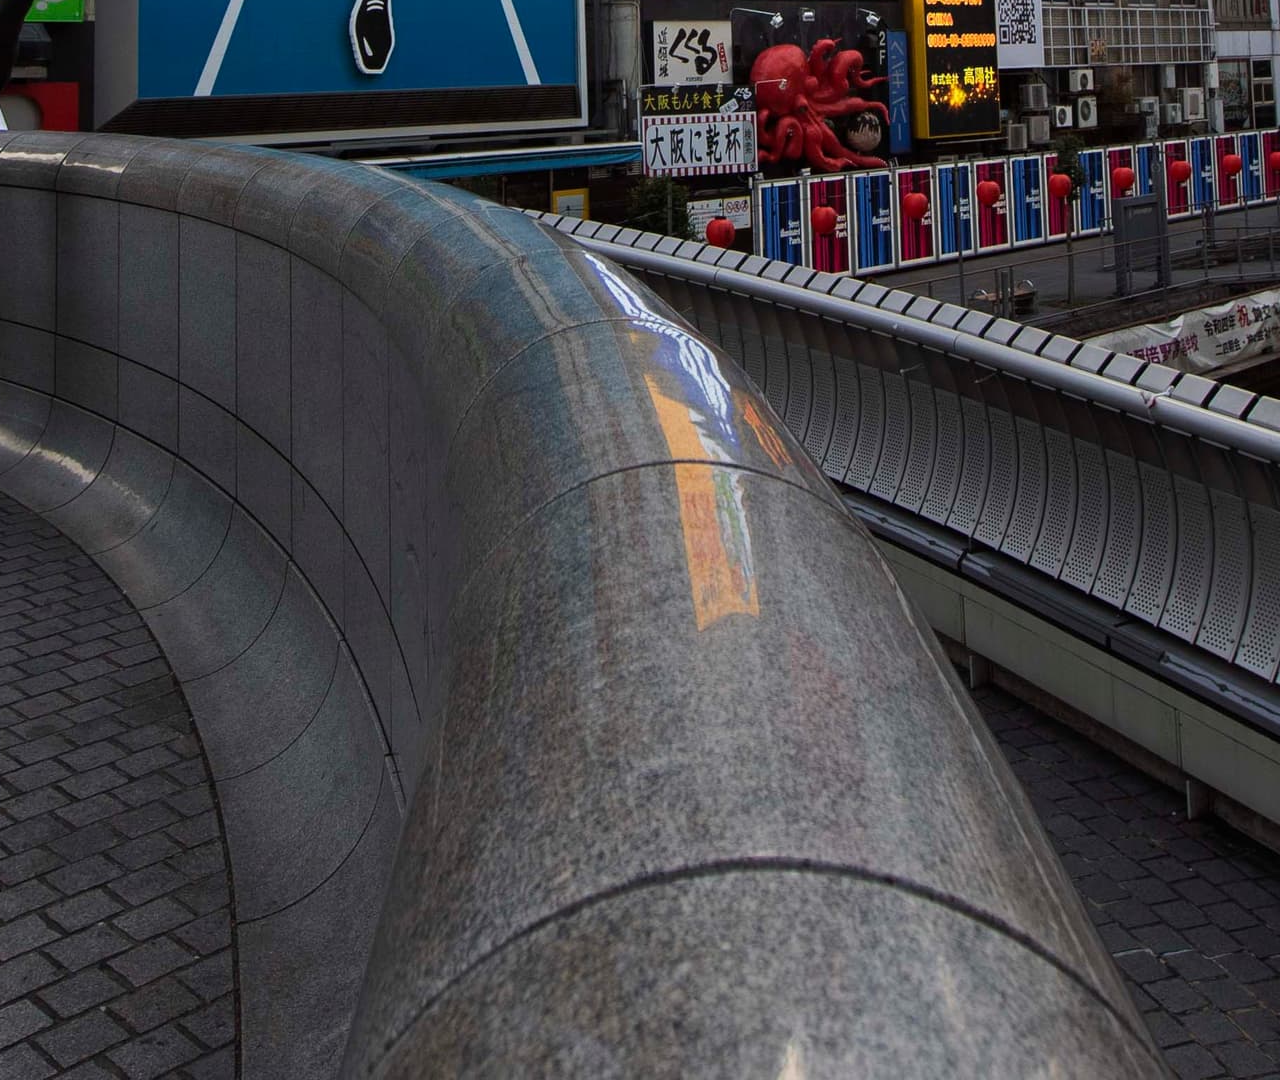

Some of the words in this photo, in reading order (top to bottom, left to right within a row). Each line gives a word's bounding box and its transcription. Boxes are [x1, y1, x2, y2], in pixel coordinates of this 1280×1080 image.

[878, 31, 887, 65] 2F
[650, 123, 742, 167] 大阪に乾杯
